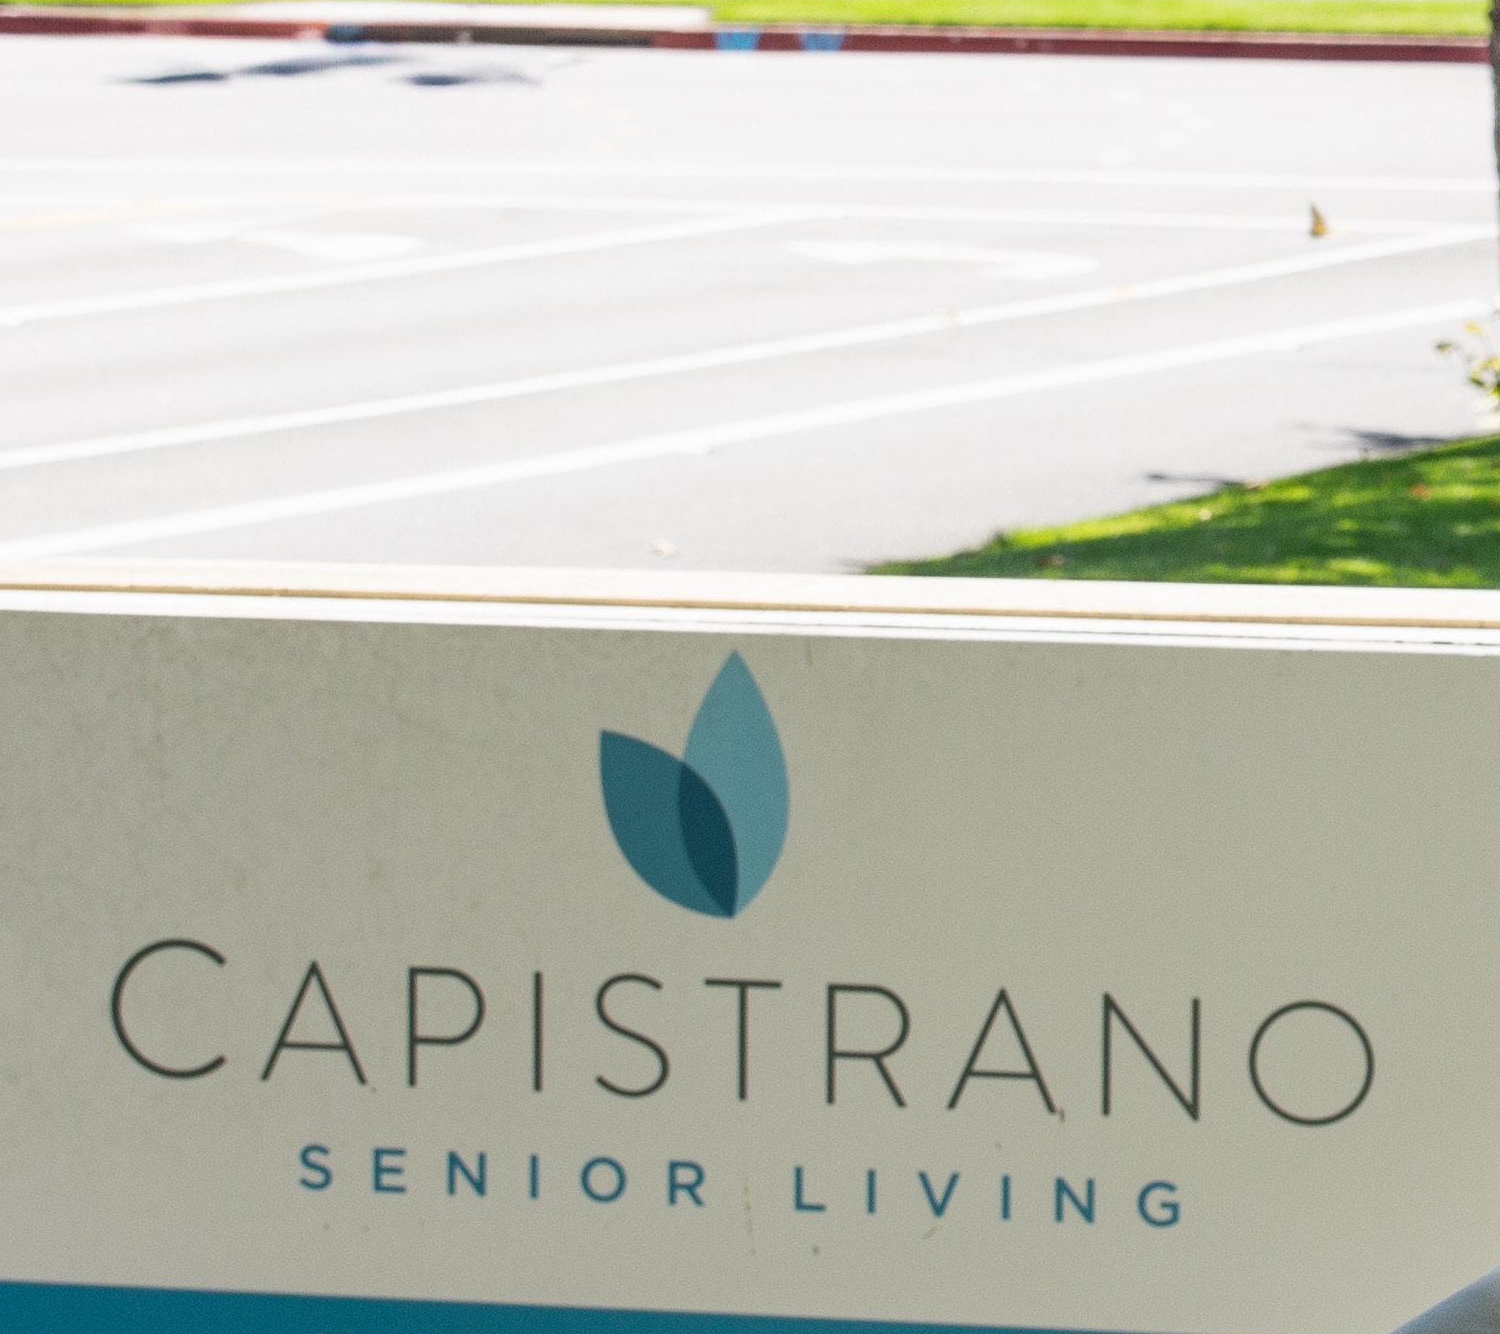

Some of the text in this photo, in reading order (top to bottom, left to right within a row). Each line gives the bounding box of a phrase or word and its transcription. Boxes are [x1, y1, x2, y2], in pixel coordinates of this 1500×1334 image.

[111, 937, 1375, 1127] CAPISTRANO
[299, 1144, 1181, 1228] SENIOR LIVING
